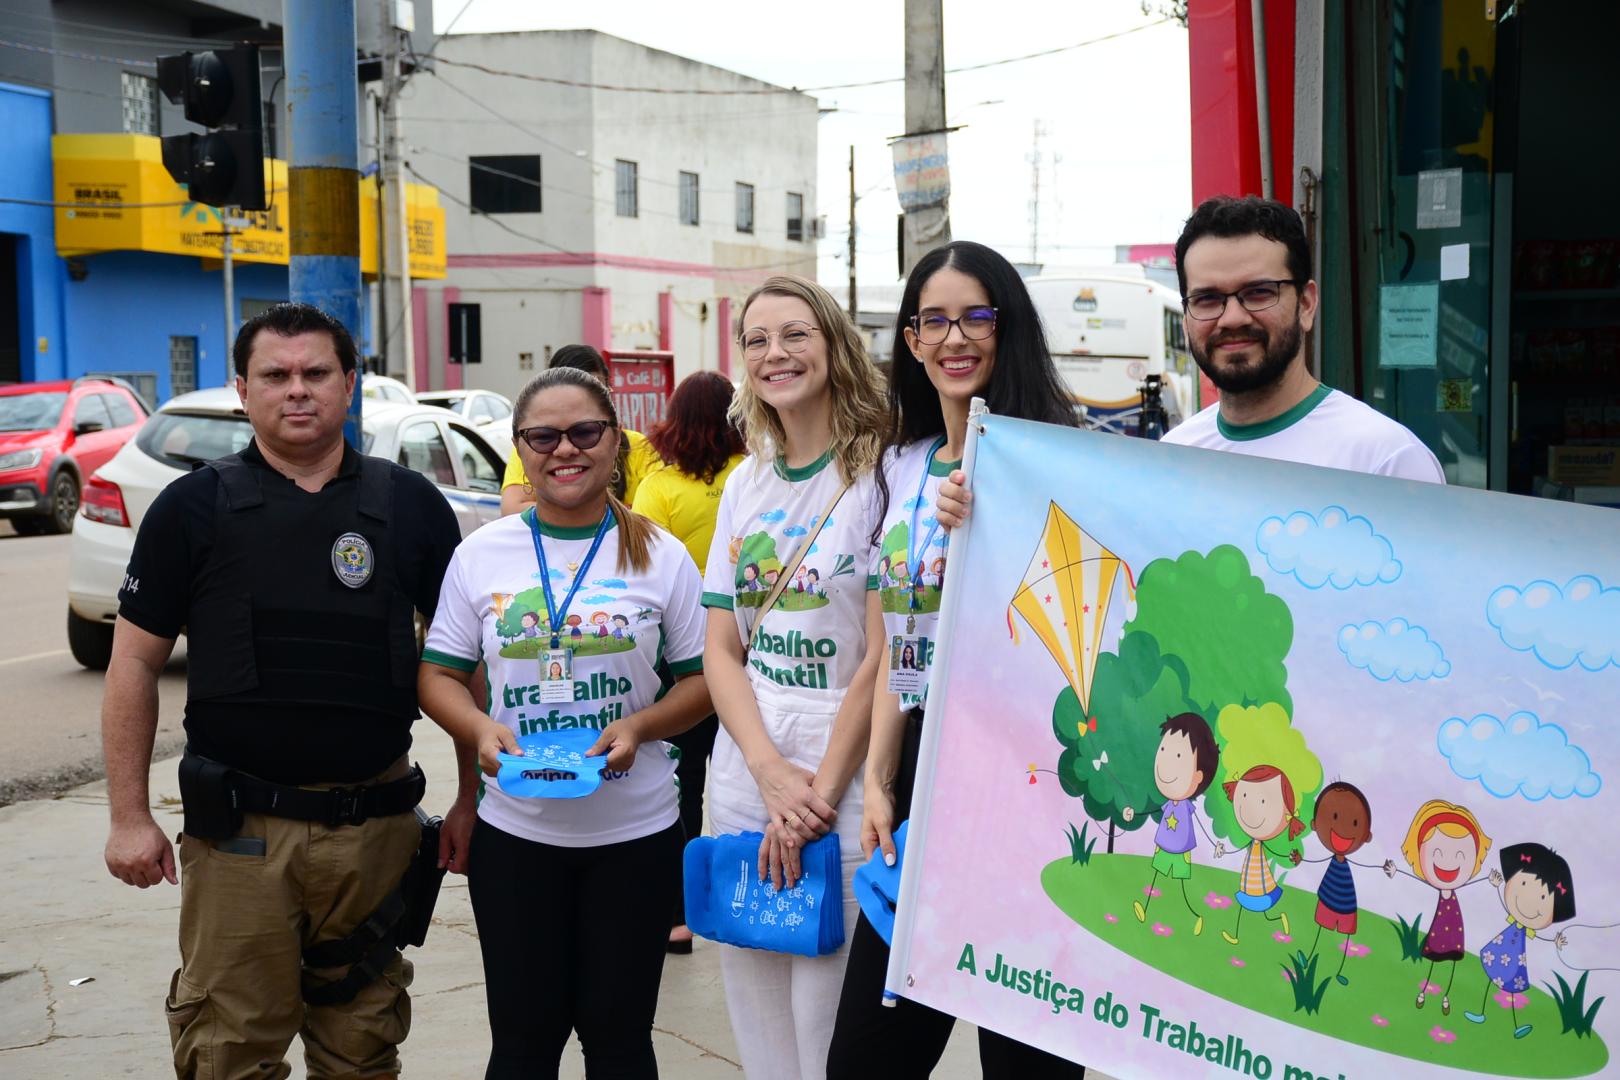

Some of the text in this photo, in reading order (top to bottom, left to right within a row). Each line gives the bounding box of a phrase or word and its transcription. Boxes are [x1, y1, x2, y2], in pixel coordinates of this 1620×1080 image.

[626, 370, 650, 385] Café
[502, 671, 633, 709] traalho
[957, 943, 1273, 1080] A Justiça do Trabalho
